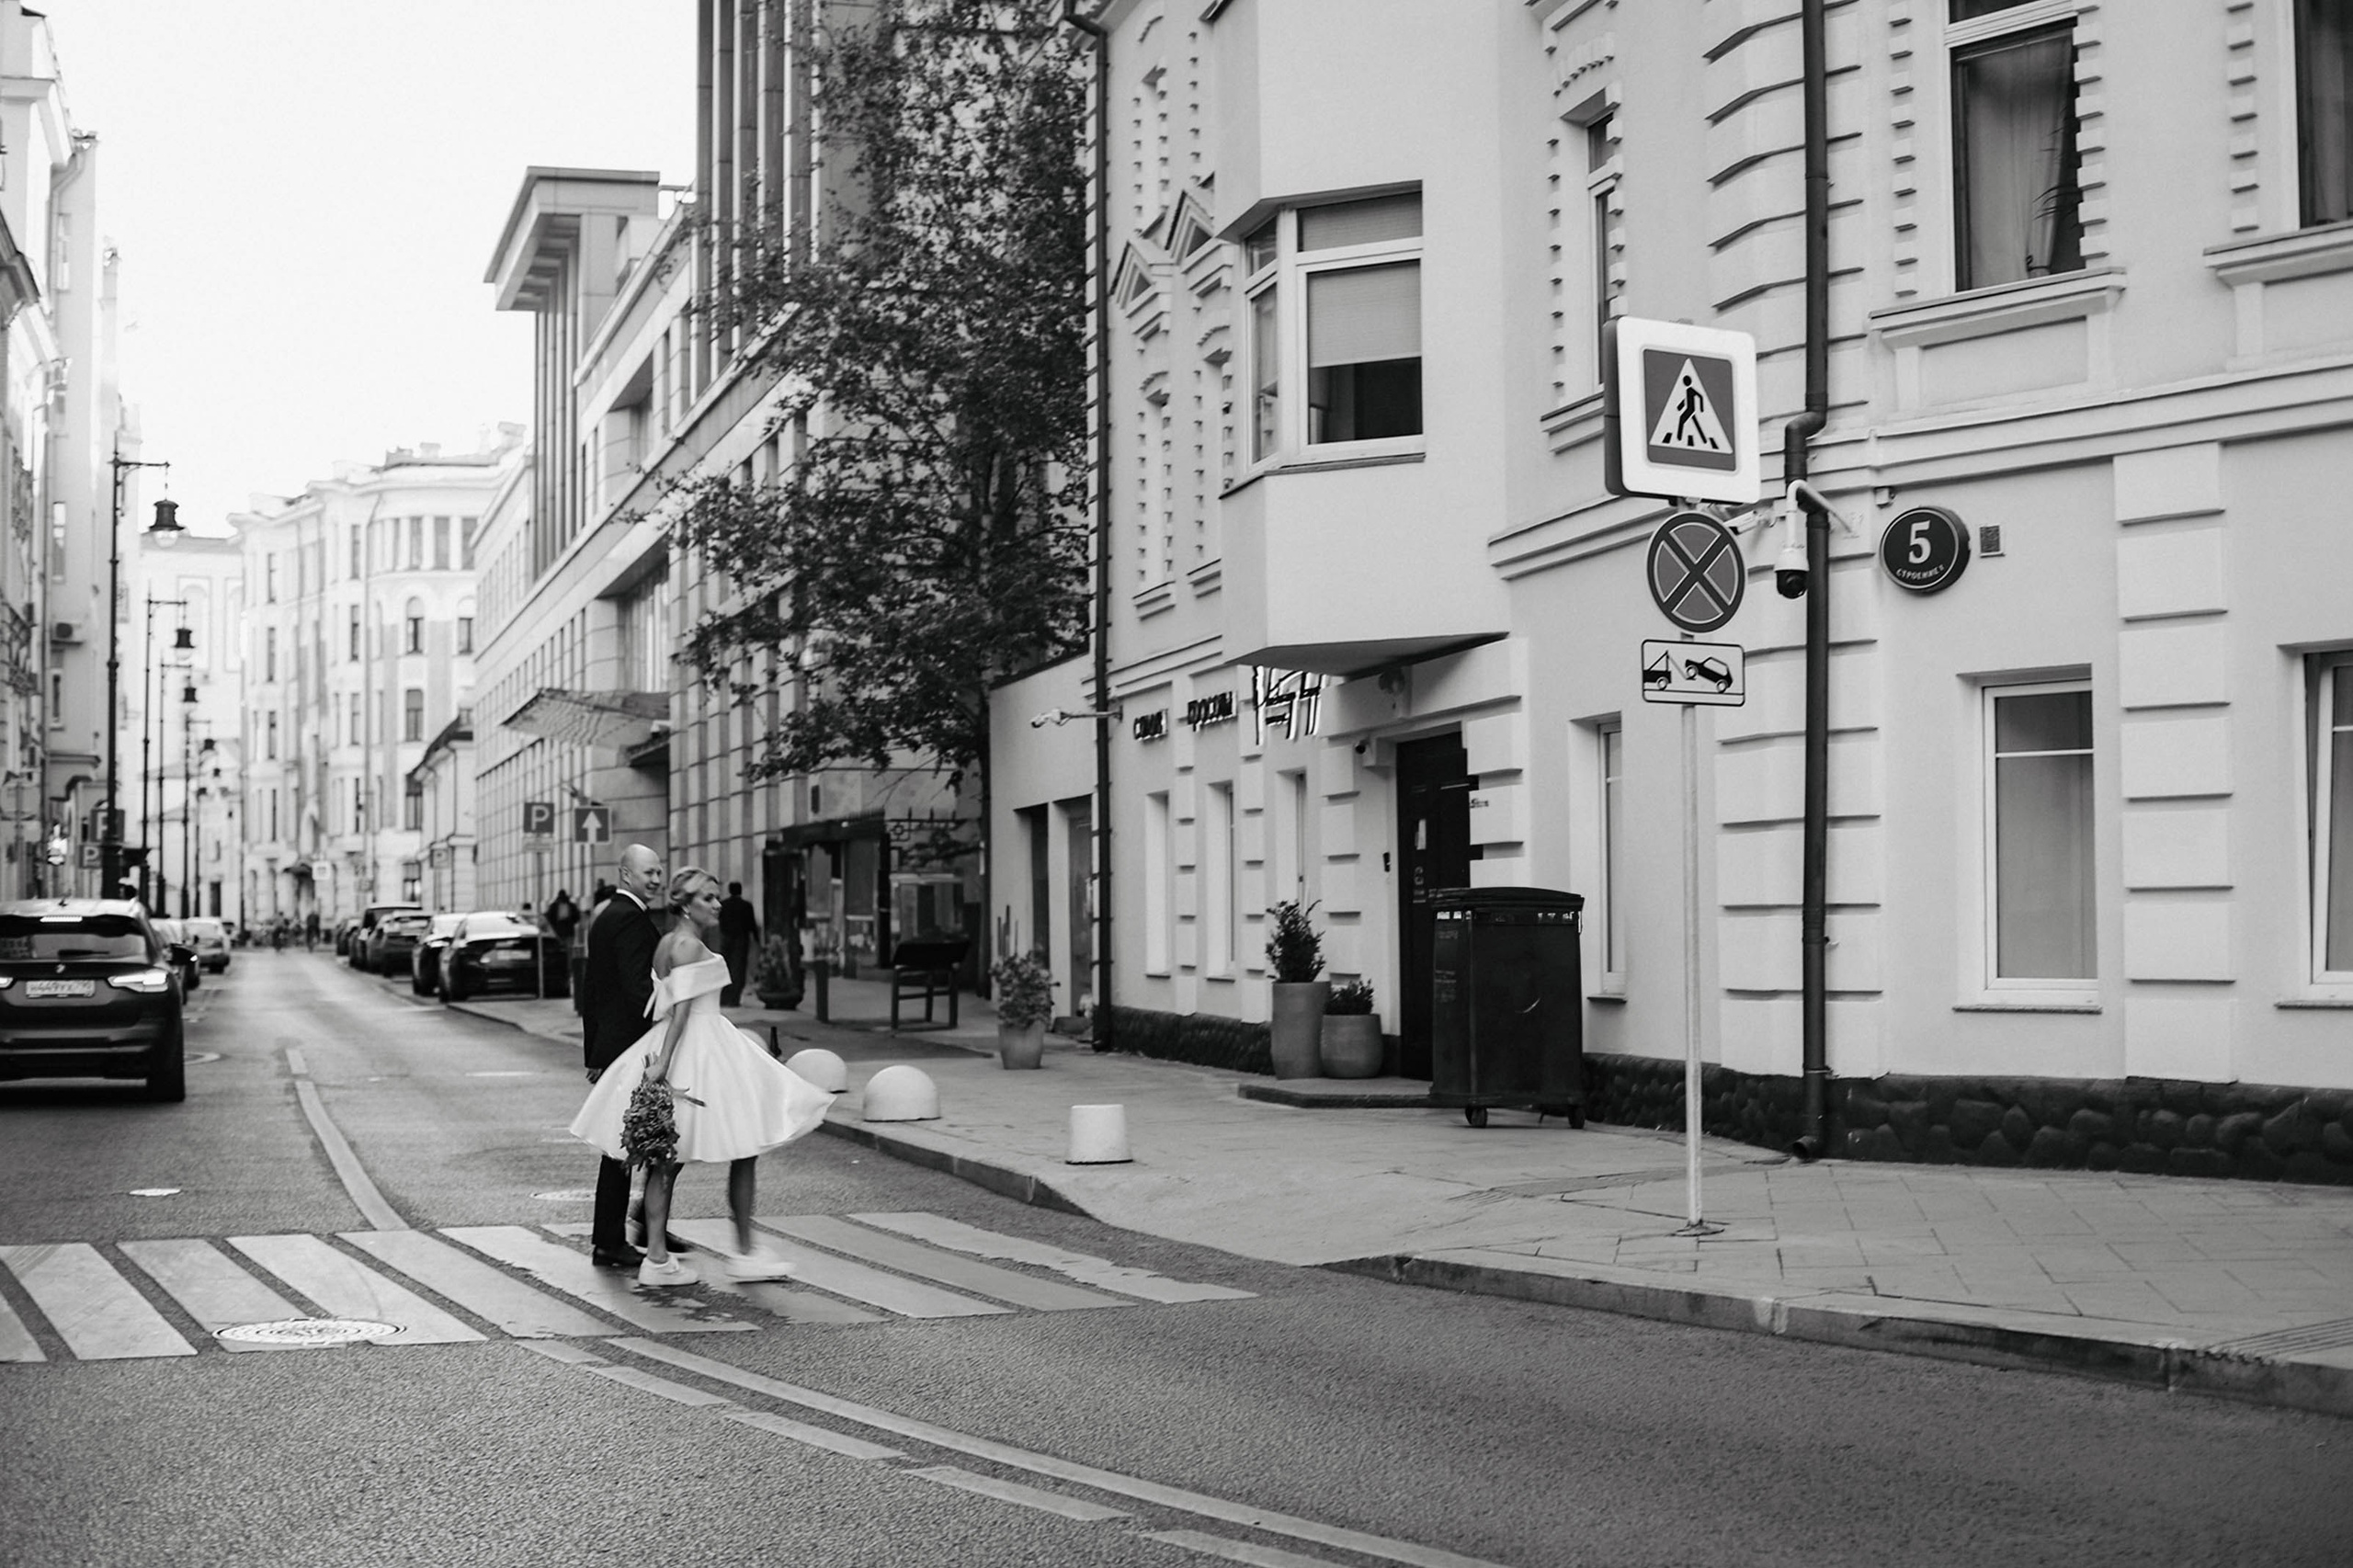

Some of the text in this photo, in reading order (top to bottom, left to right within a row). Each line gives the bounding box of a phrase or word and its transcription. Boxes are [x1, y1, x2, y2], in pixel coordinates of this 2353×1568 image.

[1908, 519, 1931, 564] 5
[1896, 566, 1939, 580] СТРОЕНИЕ
[530, 805, 551, 831] P
